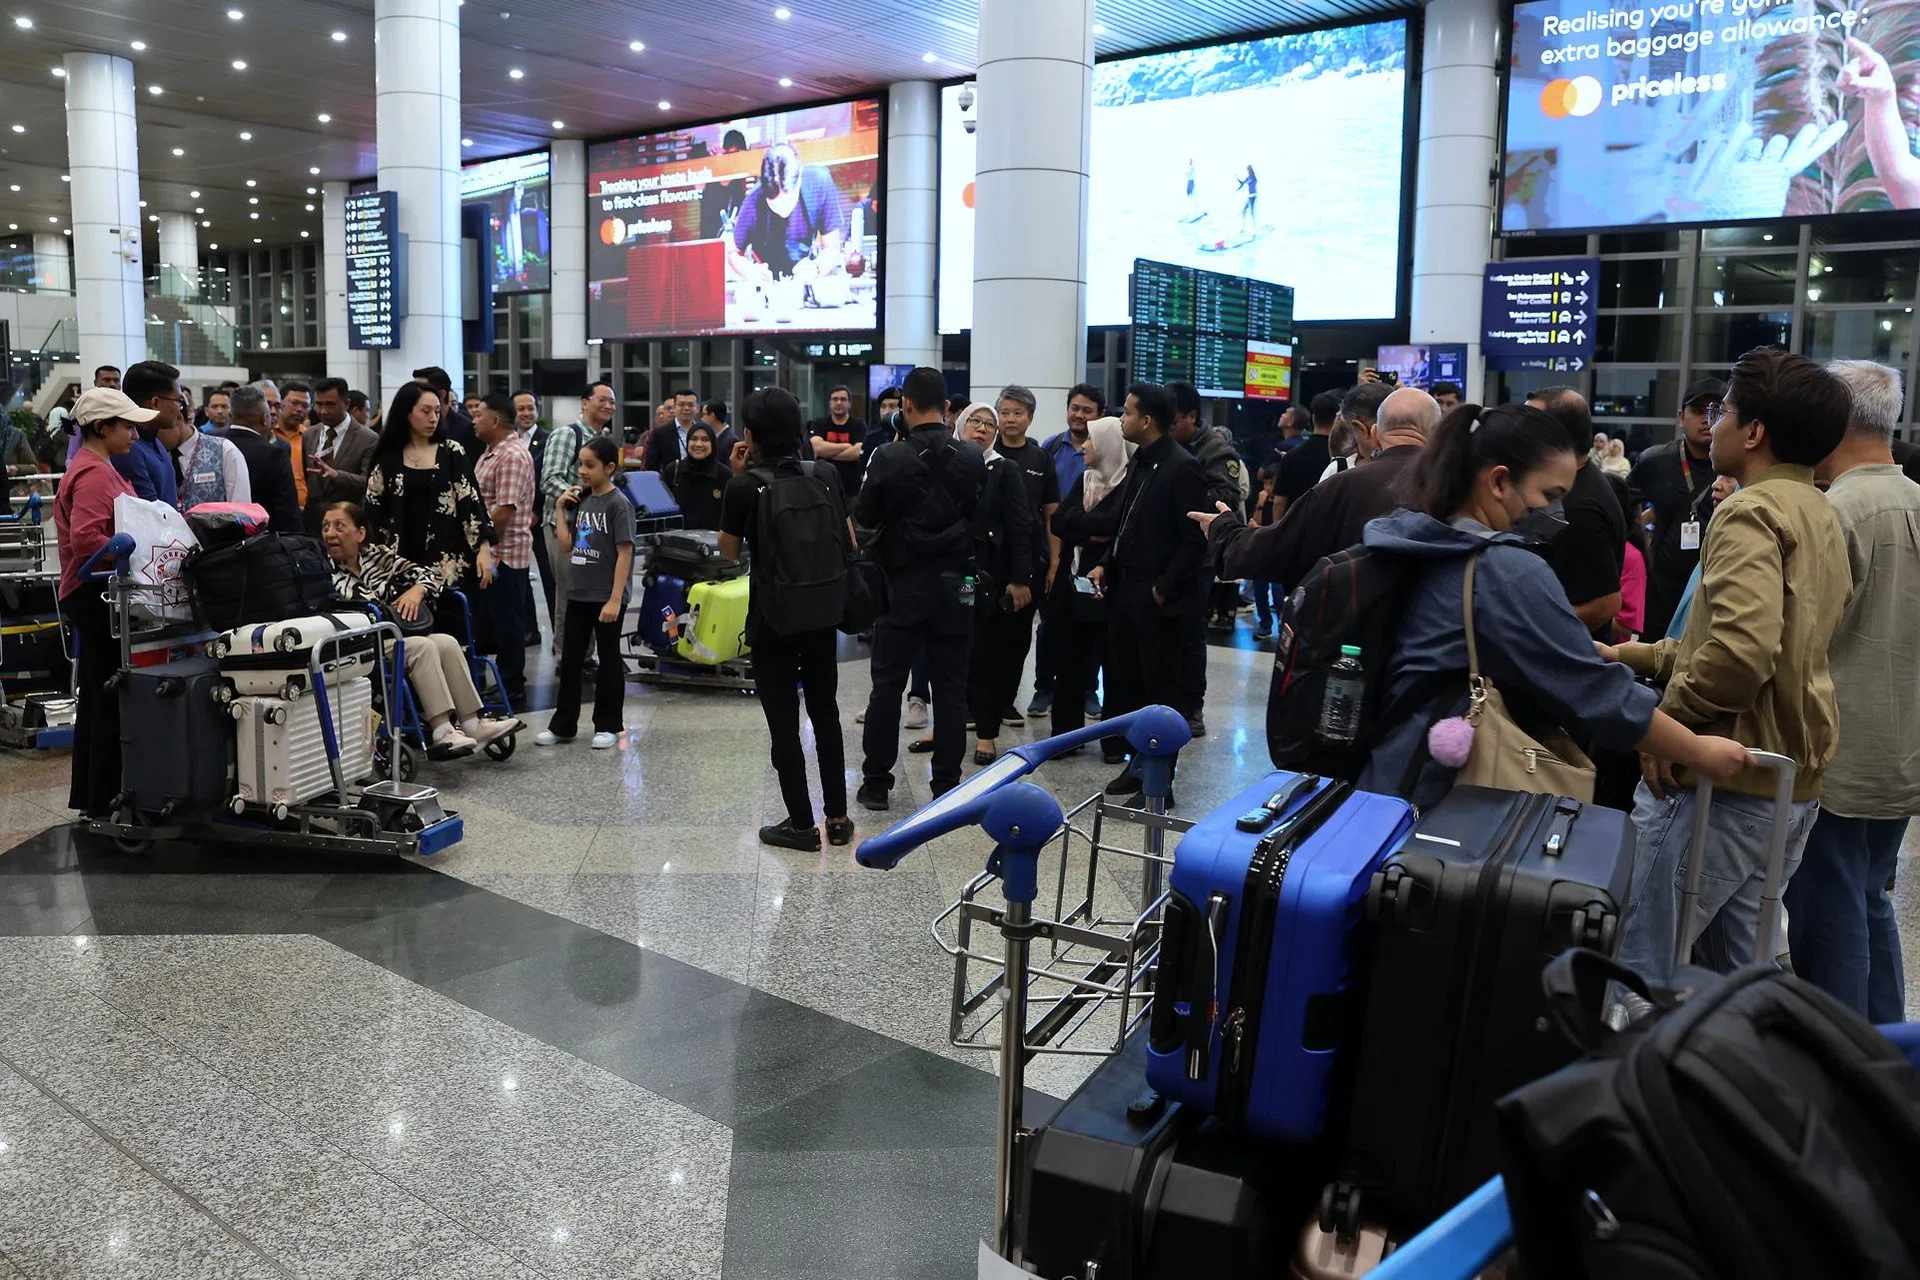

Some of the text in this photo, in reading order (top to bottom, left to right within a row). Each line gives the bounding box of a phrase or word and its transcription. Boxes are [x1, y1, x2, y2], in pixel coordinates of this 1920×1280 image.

[1543, 7, 1644, 37] Realising
[1649, 0, 1725, 28] you're
[1540, 41, 1599, 66] extra
[1606, 29, 1713, 57] baggage
[1611, 71, 1728, 107] priceless
[599, 178, 637, 195] Treating
[637, 175, 660, 192] your
[601, 198, 614, 212] to
[614, 192, 660, 210] first-class
[627, 217, 673, 238] priceless
